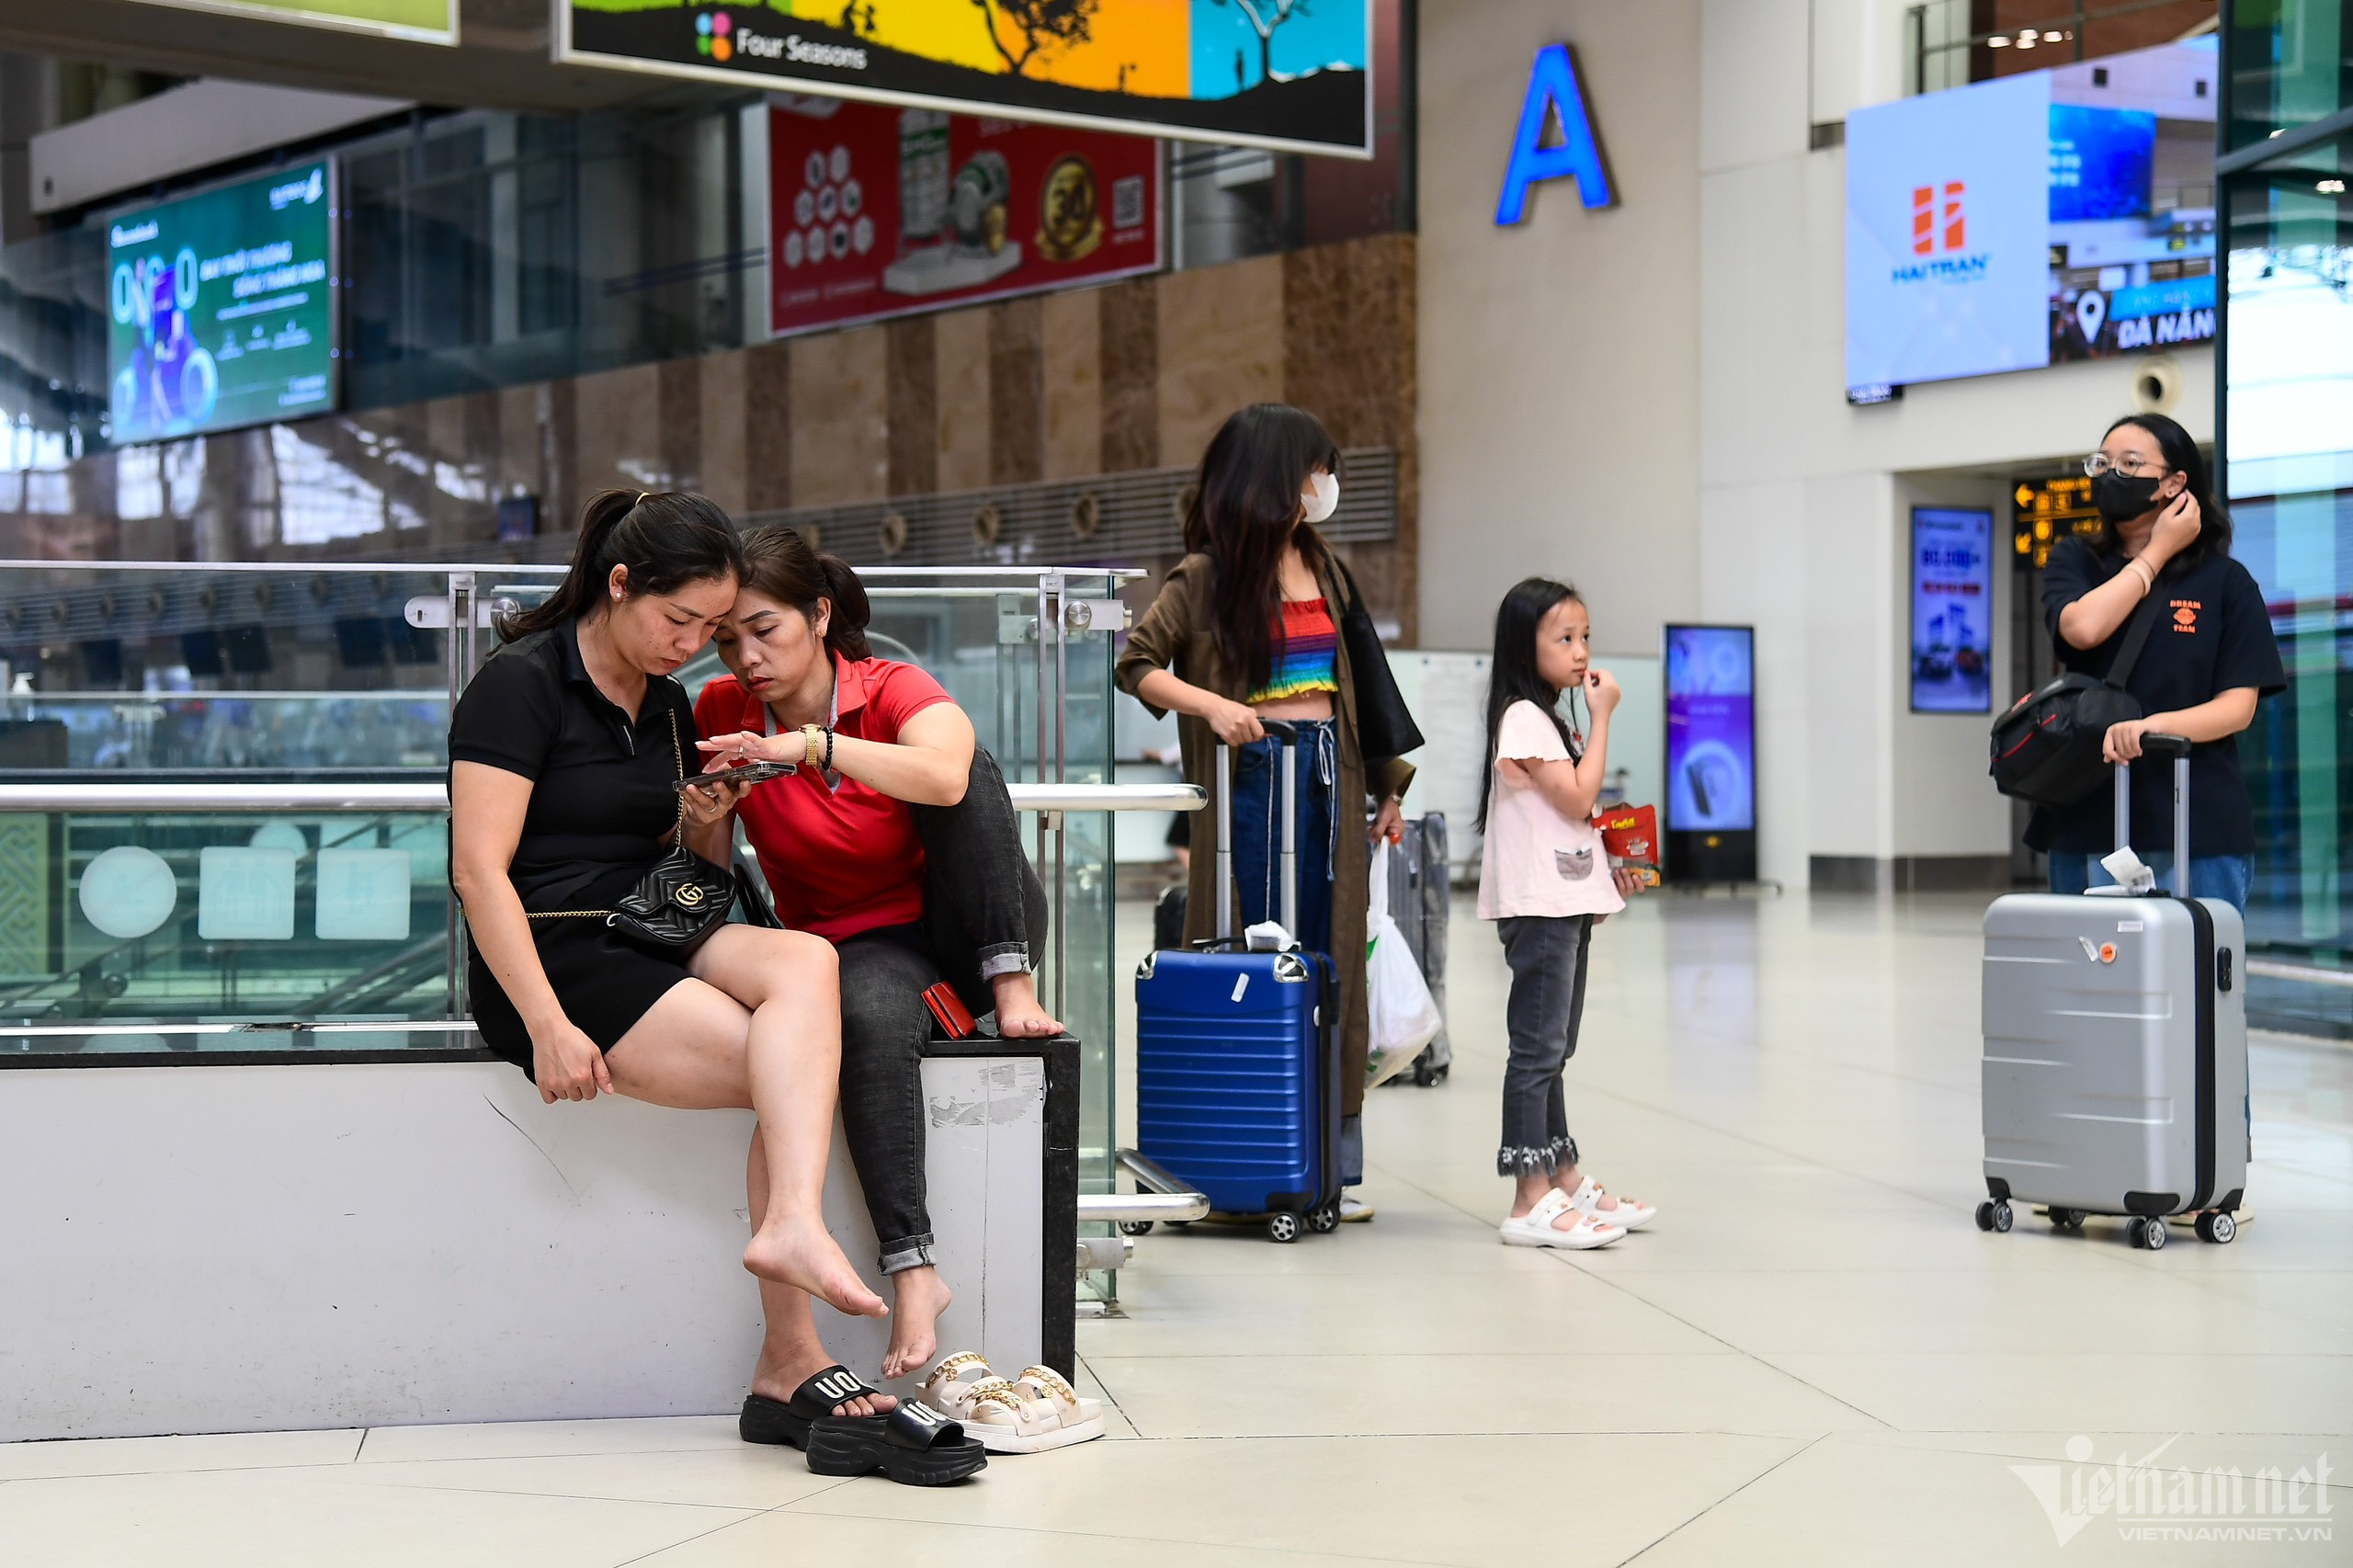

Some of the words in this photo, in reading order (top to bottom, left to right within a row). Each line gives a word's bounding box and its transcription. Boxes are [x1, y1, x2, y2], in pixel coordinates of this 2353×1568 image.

[736, 28, 783, 59] Four
[786, 34, 868, 70] Seasons
[1495, 43, 1610, 225] A
[2170, 599, 2201, 609] DREAM
[2174, 624, 2196, 633] TEAM
